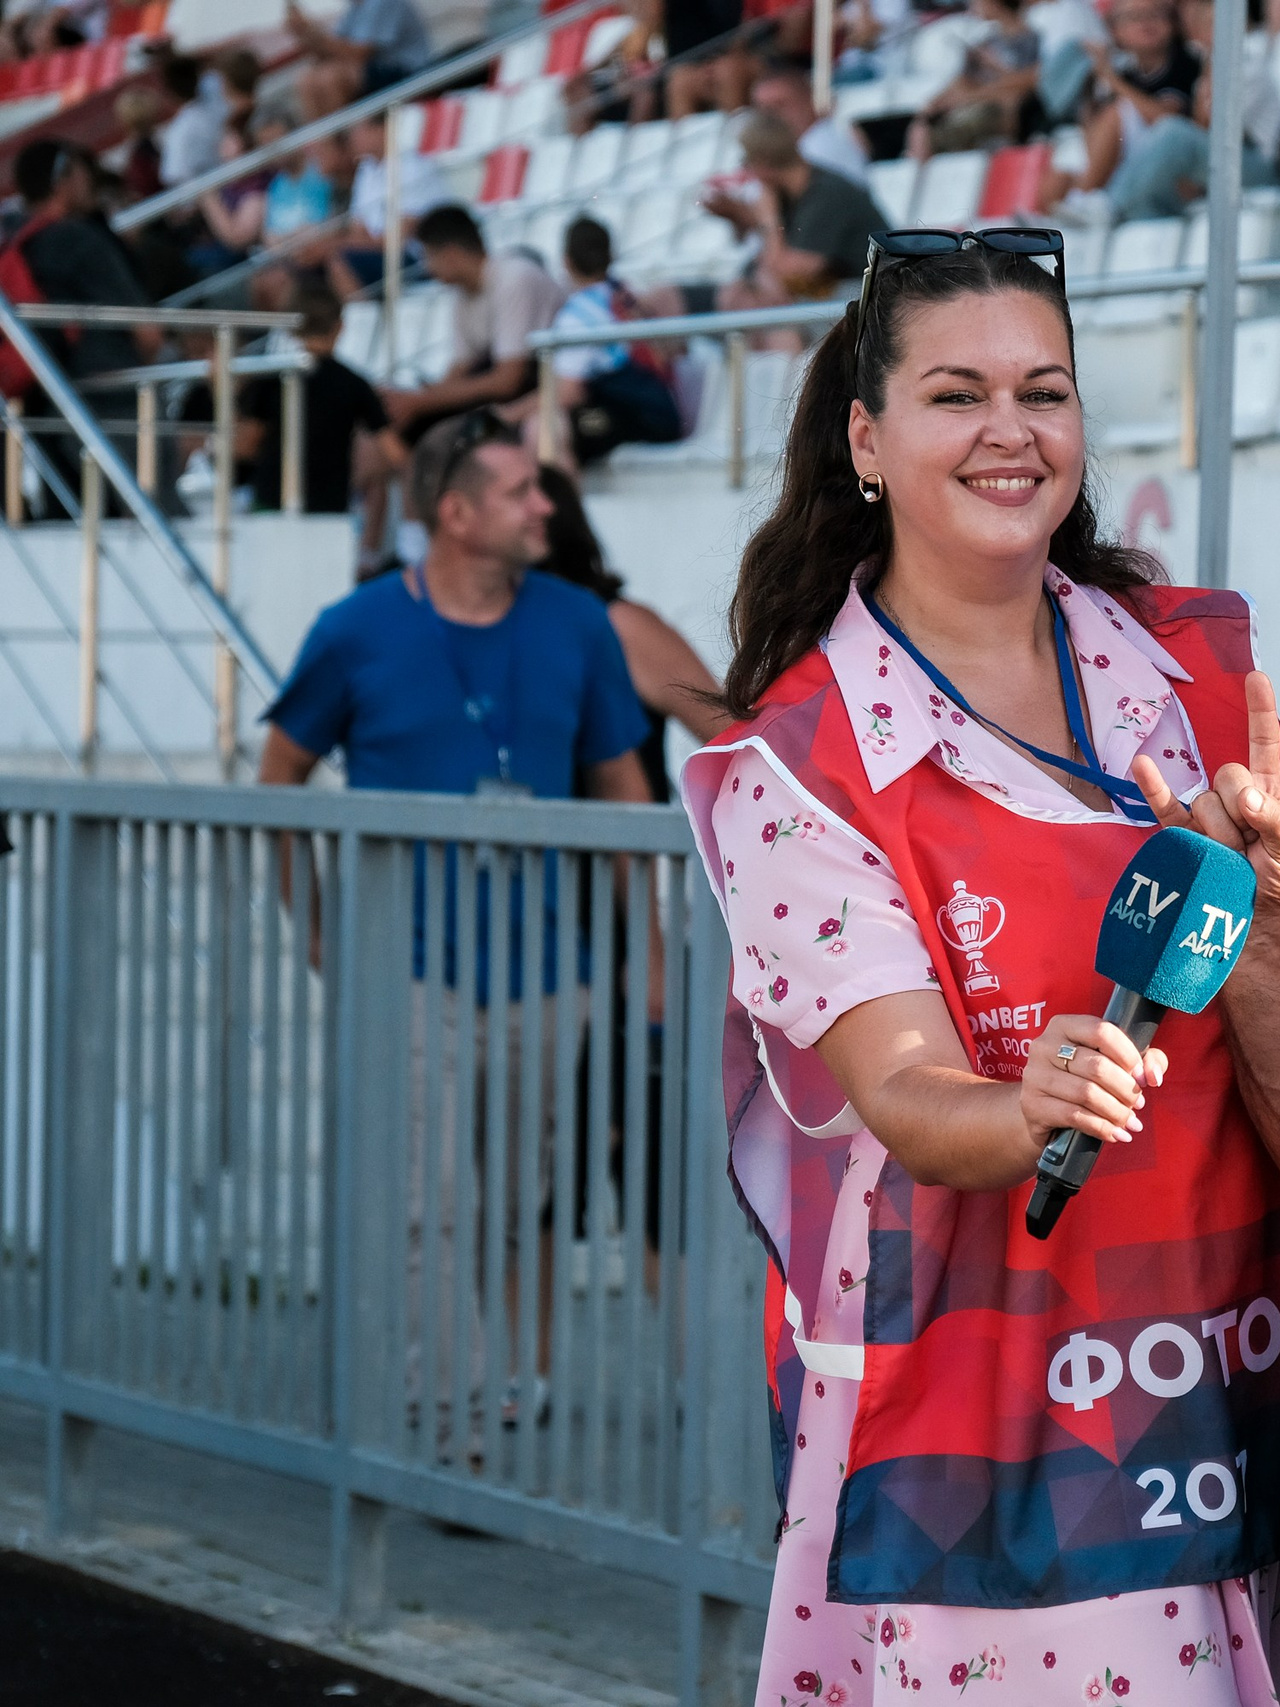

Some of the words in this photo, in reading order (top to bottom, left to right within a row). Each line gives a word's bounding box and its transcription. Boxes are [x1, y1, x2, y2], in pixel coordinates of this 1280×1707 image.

[1126, 872, 1181, 918] TV
[1200, 903, 1248, 949] TV
[965, 1000, 1047, 1035] ONBET
[1001, 1037, 1034, 1058] РОС
[997, 1062, 1026, 1077] ФУТБО
